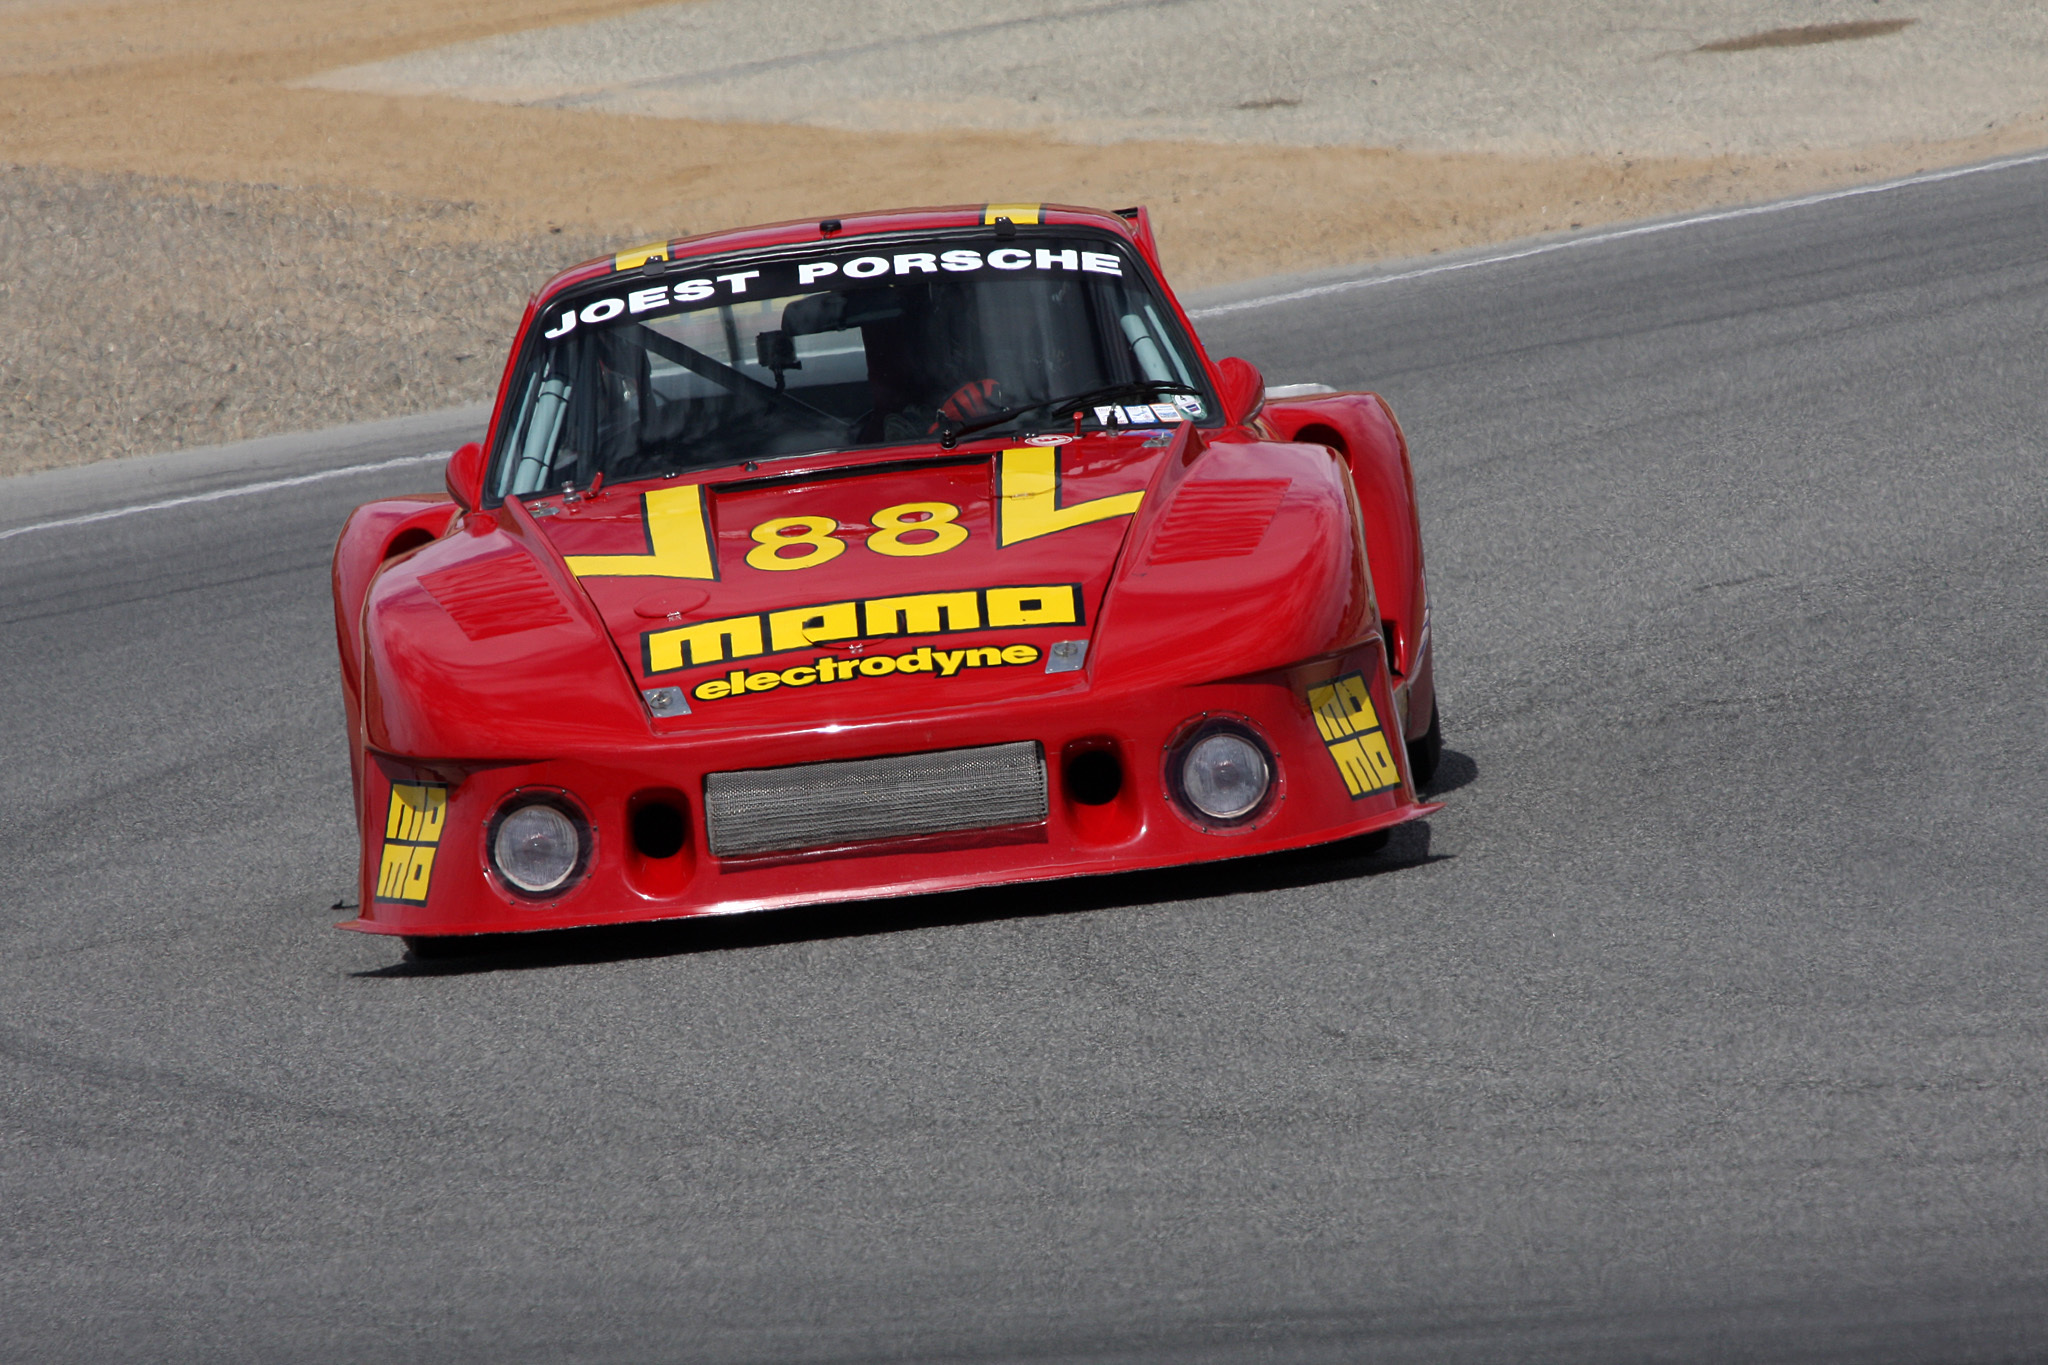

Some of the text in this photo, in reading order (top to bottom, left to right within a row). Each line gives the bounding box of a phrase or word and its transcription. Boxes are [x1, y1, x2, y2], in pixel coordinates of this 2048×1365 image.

[544, 248, 1123, 339] JOEST PORSCHE
[744, 501, 970, 572] 88
[694, 645, 1039, 700] electrodyne
